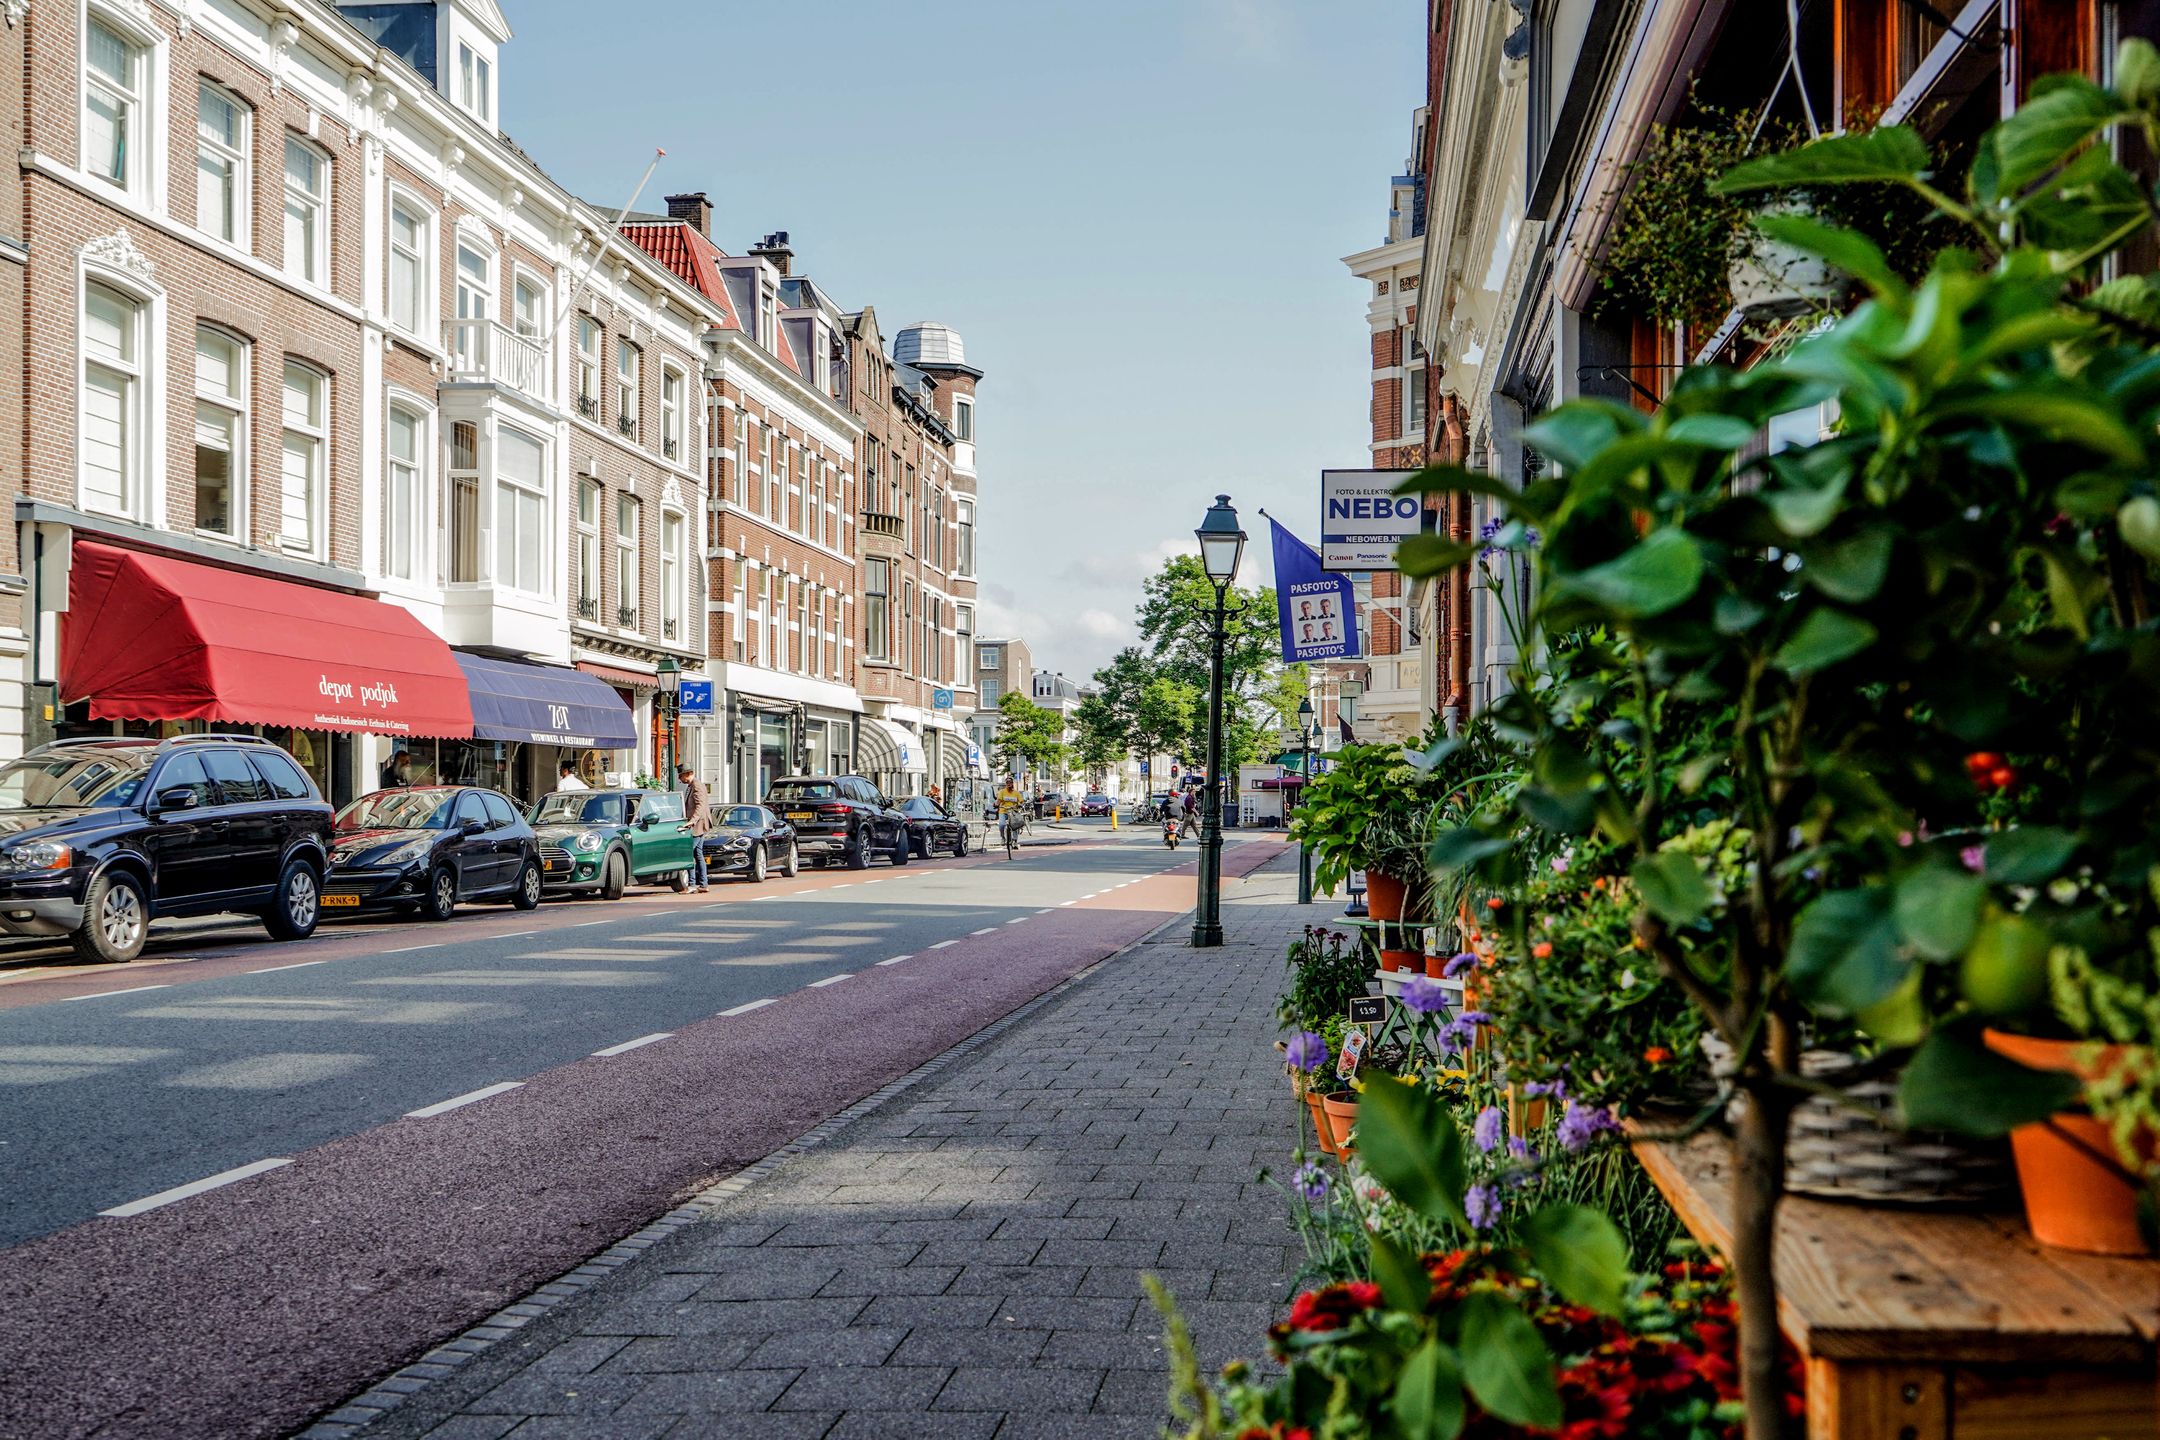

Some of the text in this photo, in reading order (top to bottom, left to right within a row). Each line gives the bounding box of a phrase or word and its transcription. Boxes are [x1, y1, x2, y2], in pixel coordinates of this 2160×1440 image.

[1335, 488, 1355, 496] FOTO
[1356, 488, 1362, 496] &
[1329, 497, 1419, 519] NEBO
[1345, 535, 1403, 543] NEBOWEB.NL
[1290, 580, 1339, 594] PASFOTO'S
[1296, 645, 1345, 658] PASFOTO'S
[319, 674, 399, 709] depot podjok
[684, 691, 694, 705] P
[971, 746, 978, 756] P
